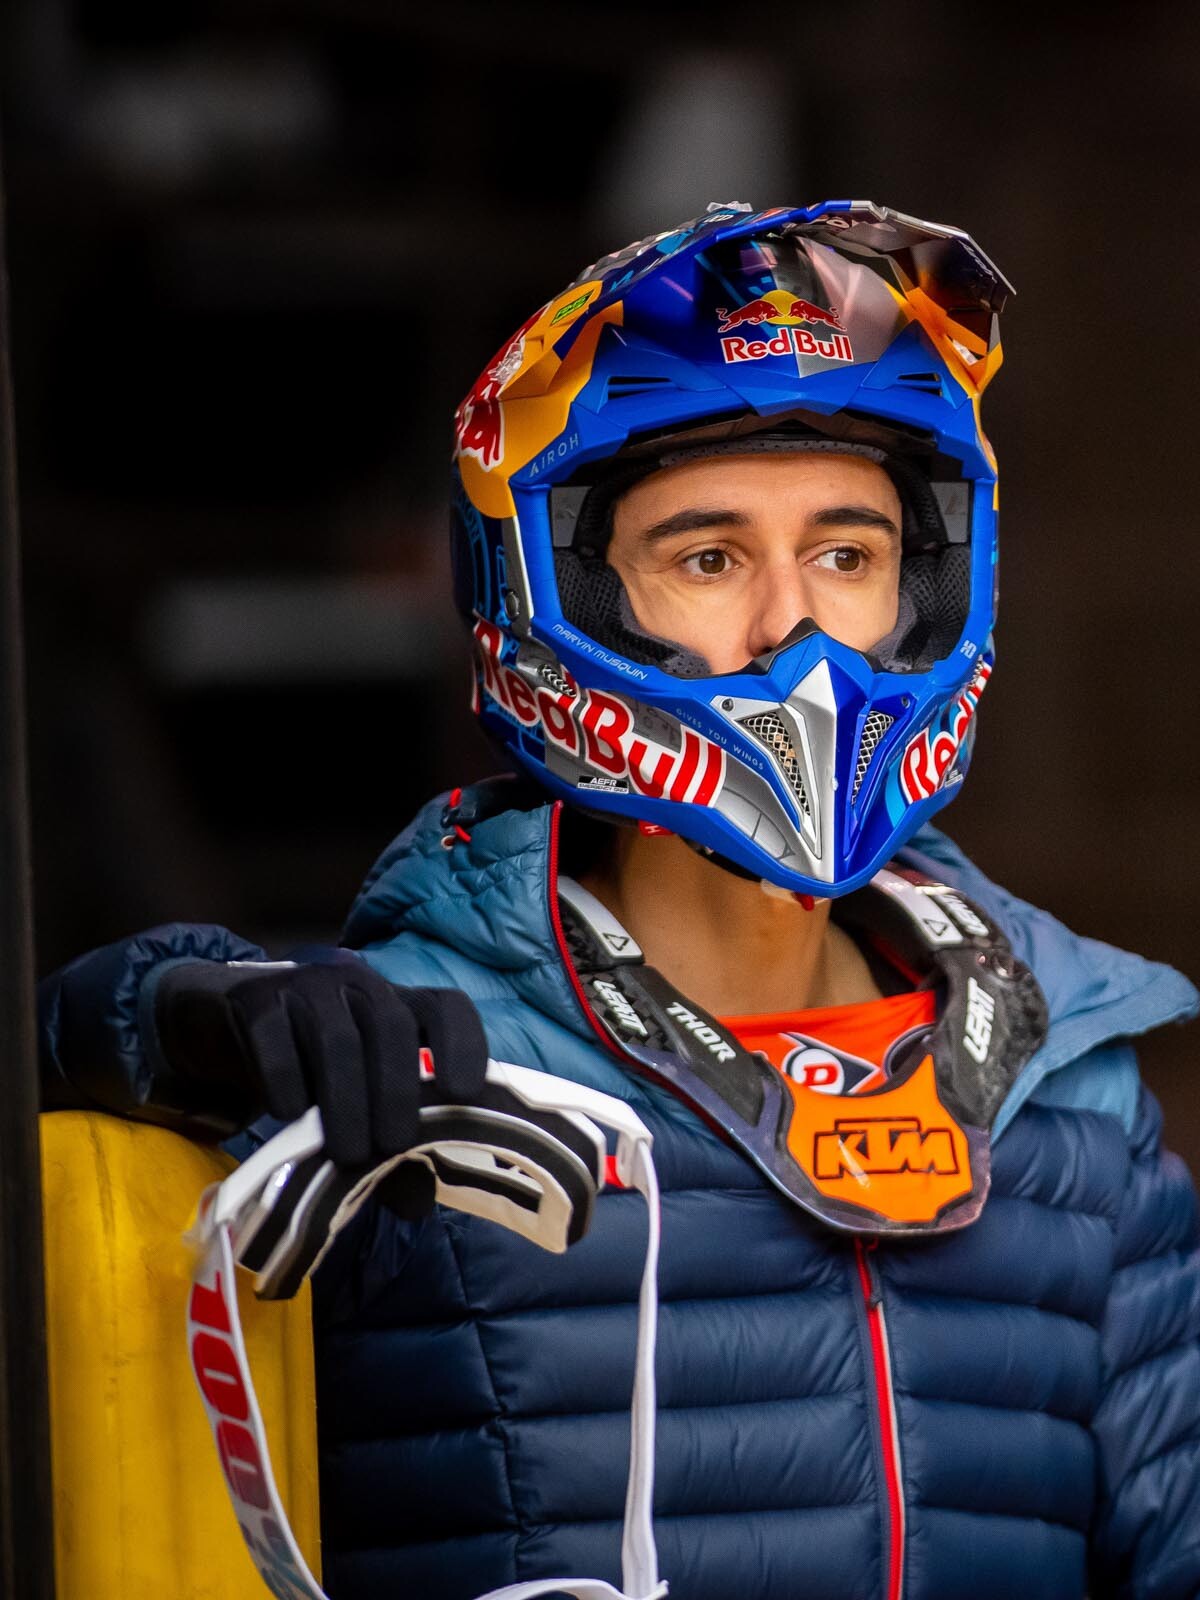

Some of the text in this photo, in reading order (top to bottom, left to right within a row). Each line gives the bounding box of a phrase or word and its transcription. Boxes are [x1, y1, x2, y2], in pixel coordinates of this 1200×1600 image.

[720, 327, 853, 363] Red Bull
[528, 432, 580, 479] AIROH
[551, 623, 648, 681] MARVIN MUSQUIN
[580, 688, 727, 808] Bull
[708, 727, 727, 745] YOU
[665, 1001, 737, 1064] THOR
[803, 1063, 839, 1087] D
[813, 1116, 960, 1180] KTM
